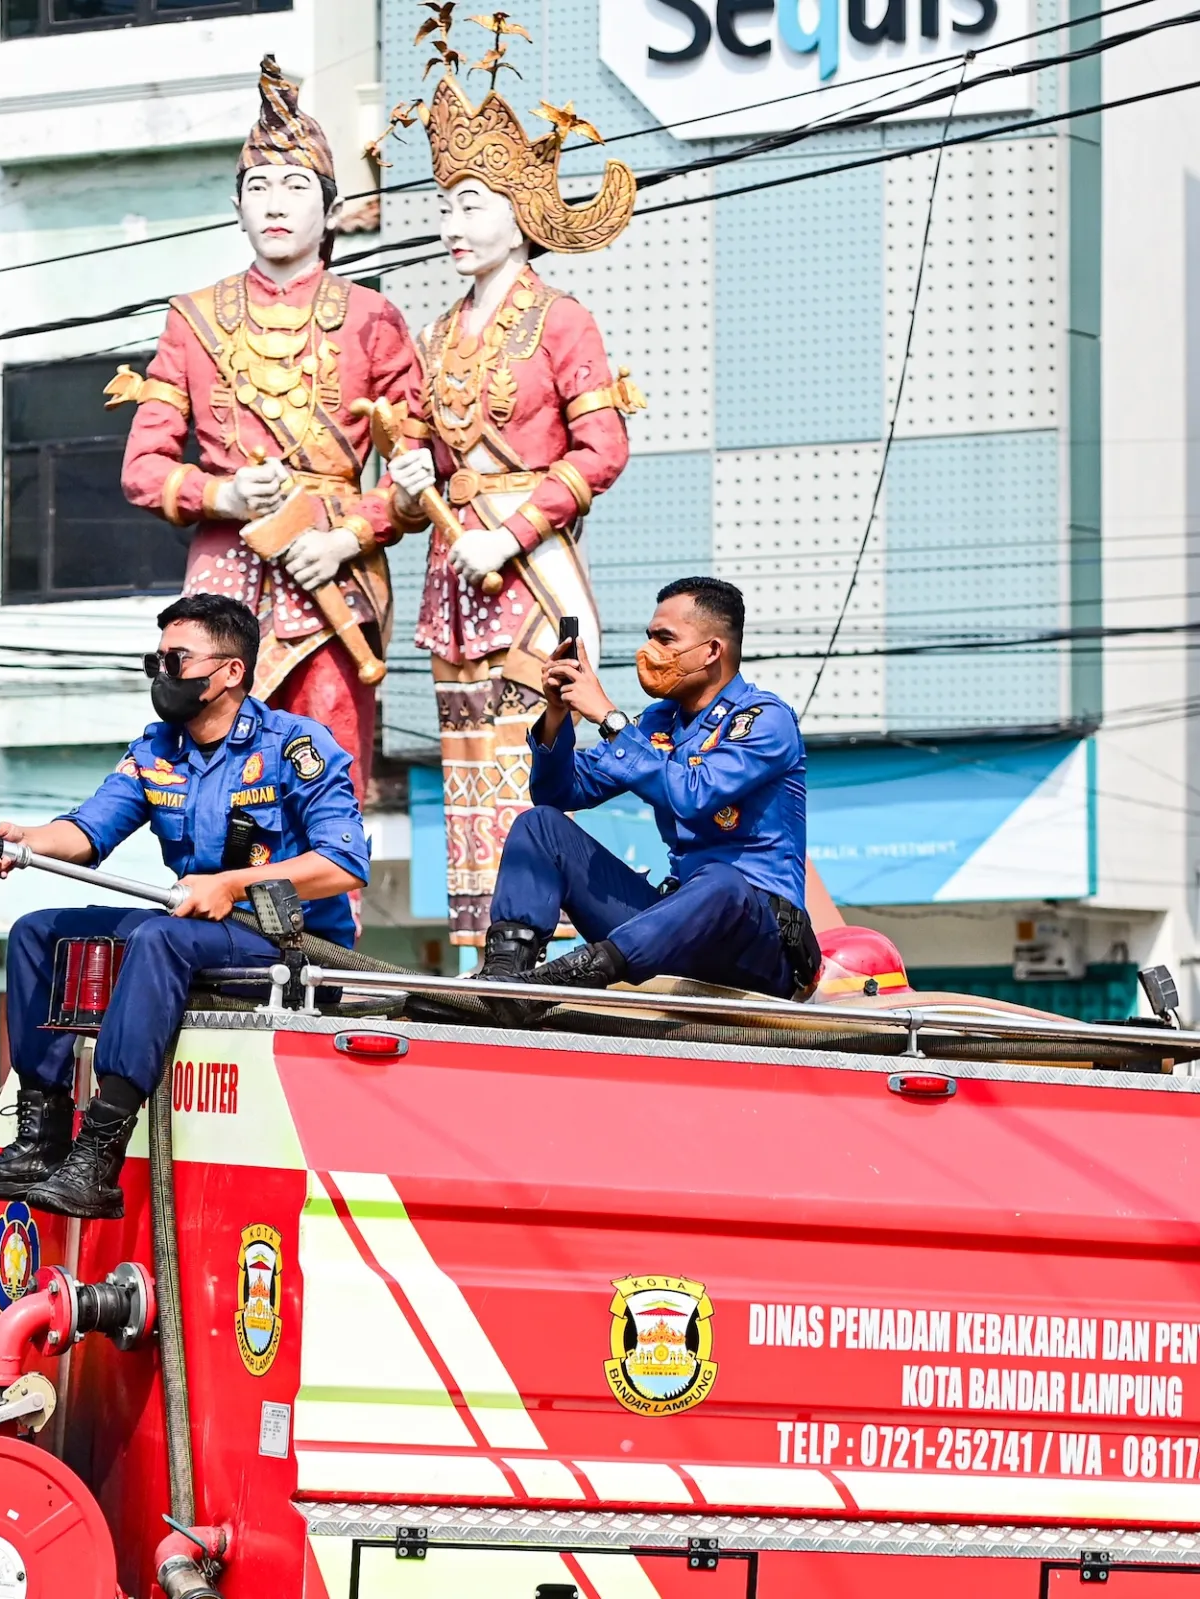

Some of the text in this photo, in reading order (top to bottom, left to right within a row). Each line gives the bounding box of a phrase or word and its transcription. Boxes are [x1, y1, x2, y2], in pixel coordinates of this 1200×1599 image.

[231, 786, 276, 808] PEMADAM
[196, 1062, 239, 1114] LITER
[248, 1227, 275, 1242] KOTA
[632, 1277, 687, 1290] KOTA
[236, 1319, 281, 1372] BANDAR LAMPUNG
[748, 1303, 824, 1349] DINAS
[829, 1306, 951, 1353] PEMADAM
[956, 1311, 1097, 1360] KEBAKARAN
[1102, 1319, 1150, 1362] DAN
[608, 1367, 714, 1413] BANDAR LAMPUNG
[901, 1364, 1184, 1418] KOTA BANDAR LAMPUNG
[776, 1421, 840, 1465] TELP
[860, 1424, 1033, 1473] 0721-252741
[1059, 1433, 1103, 1476] WA
[1122, 1435, 1200, 1480] 08117
